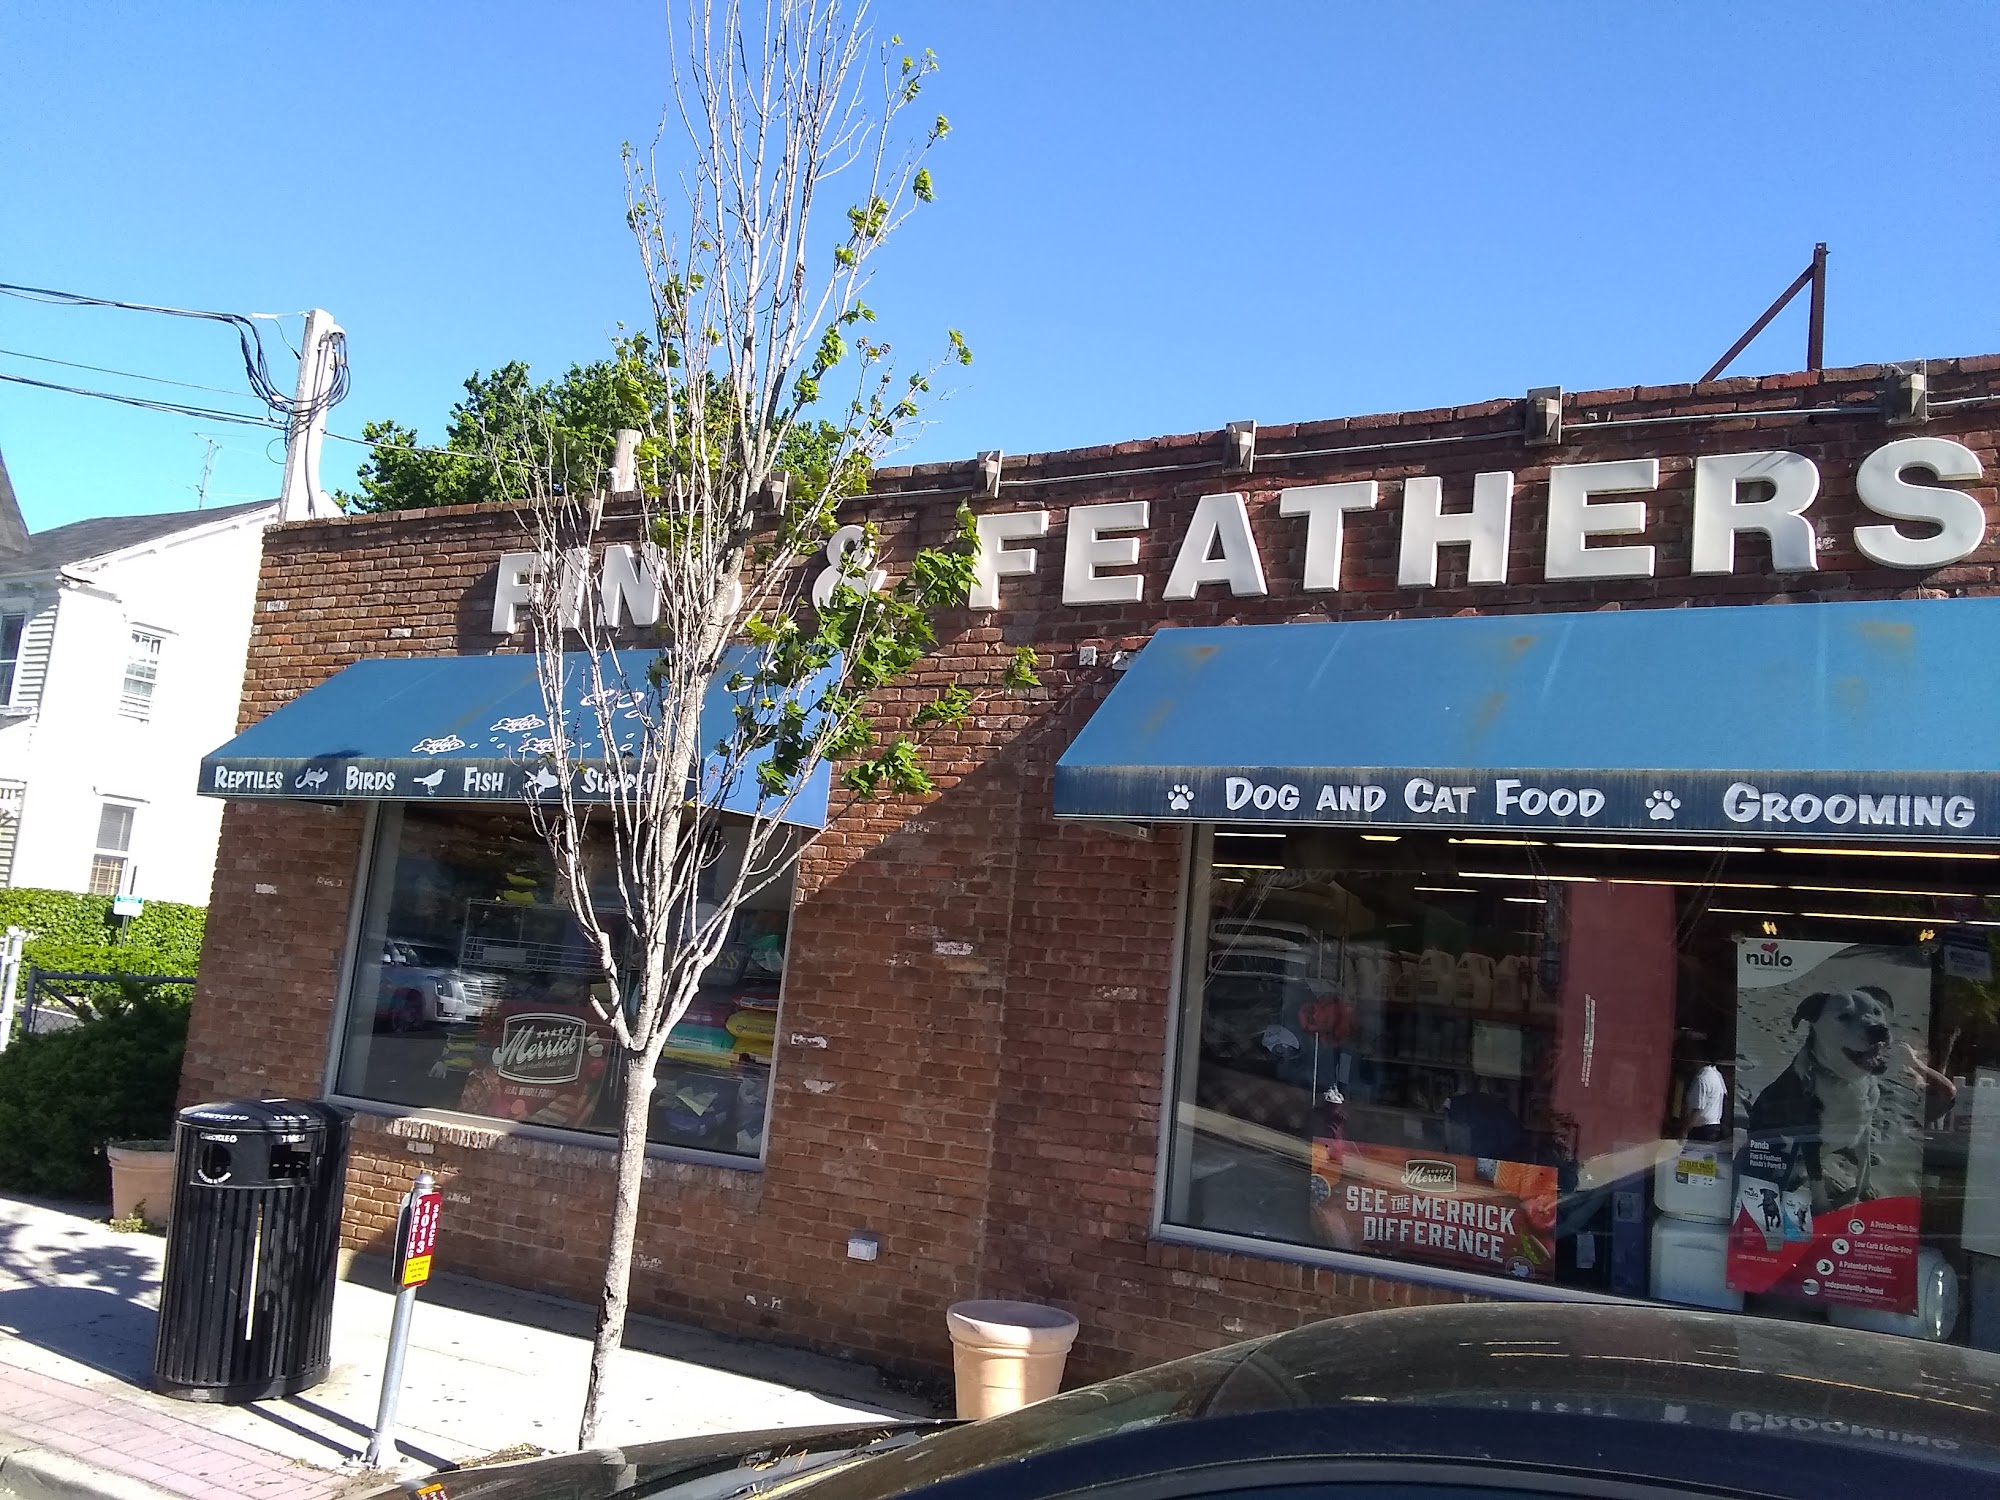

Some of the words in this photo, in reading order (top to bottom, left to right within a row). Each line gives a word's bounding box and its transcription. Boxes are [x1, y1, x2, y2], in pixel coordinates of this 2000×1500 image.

[491, 541, 742, 634] FIN
[968, 437, 1984, 611] FEATHERS
[213, 766, 284, 790] REPTILES
[345, 766, 396, 792] BIRDS
[463, 766, 504, 793] FISH
[1224, 777, 1300, 813] DOG
[1316, 783, 1387, 814] AND
[1404, 777, 1476, 815] CAT
[1496, 779, 1606, 818] FOOD
[1723, 781, 1977, 829] GROOMING
[1746, 950, 1793, 968] nulo
[492, 1025, 580, 1066] Merrick
[1750, 1140, 1770, 1150] Panda
[1401, 1165, 1452, 1185] Merrick
[408, 1199, 422, 1259] PARKING
[416, 1201, 431, 1254] 1013
[428, 1204, 440, 1247] SPACE
[1346, 1186, 1387, 1213] SEE
[1391, 1195, 1409, 1213] THE
[1412, 1194, 1516, 1235] MERRICK
[1363, 1216, 1504, 1263] DIFFERENCE
